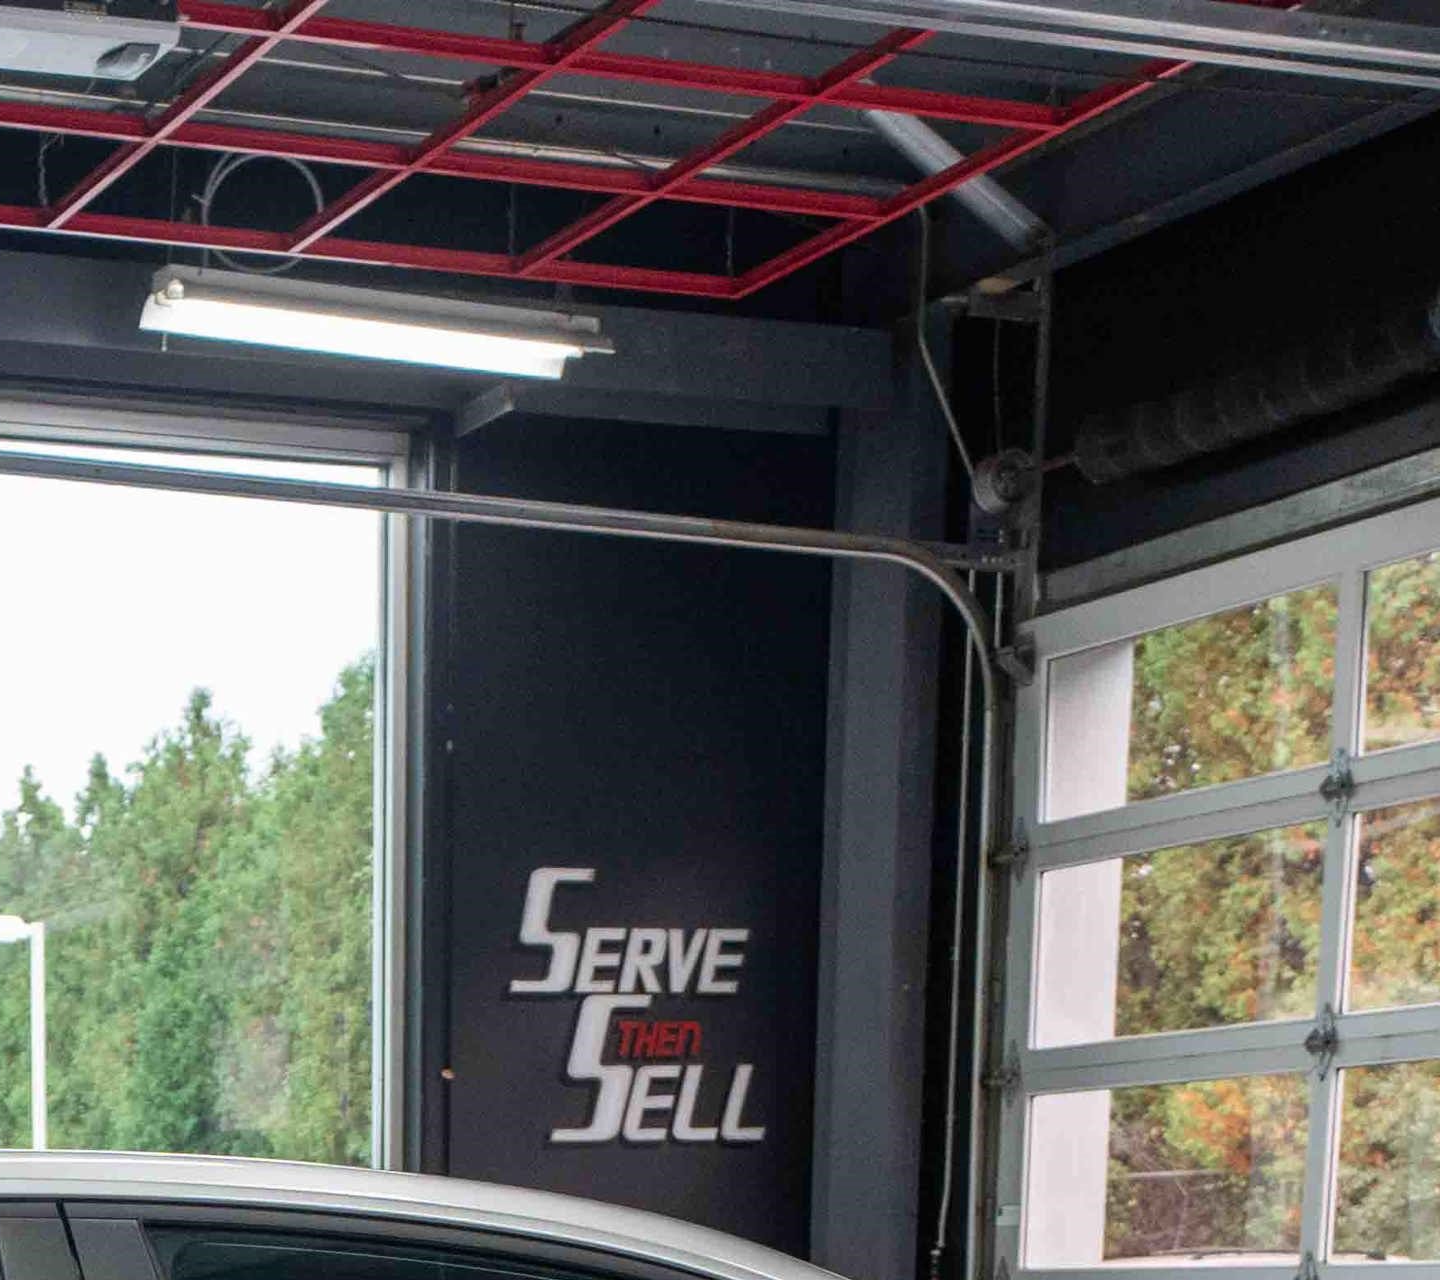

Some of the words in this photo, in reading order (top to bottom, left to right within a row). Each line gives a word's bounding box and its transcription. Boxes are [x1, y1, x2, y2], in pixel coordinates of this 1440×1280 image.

[509, 866, 750, 994] SERVE
[550, 993, 766, 1142] SELL
[618, 1019, 702, 1056] THEN
